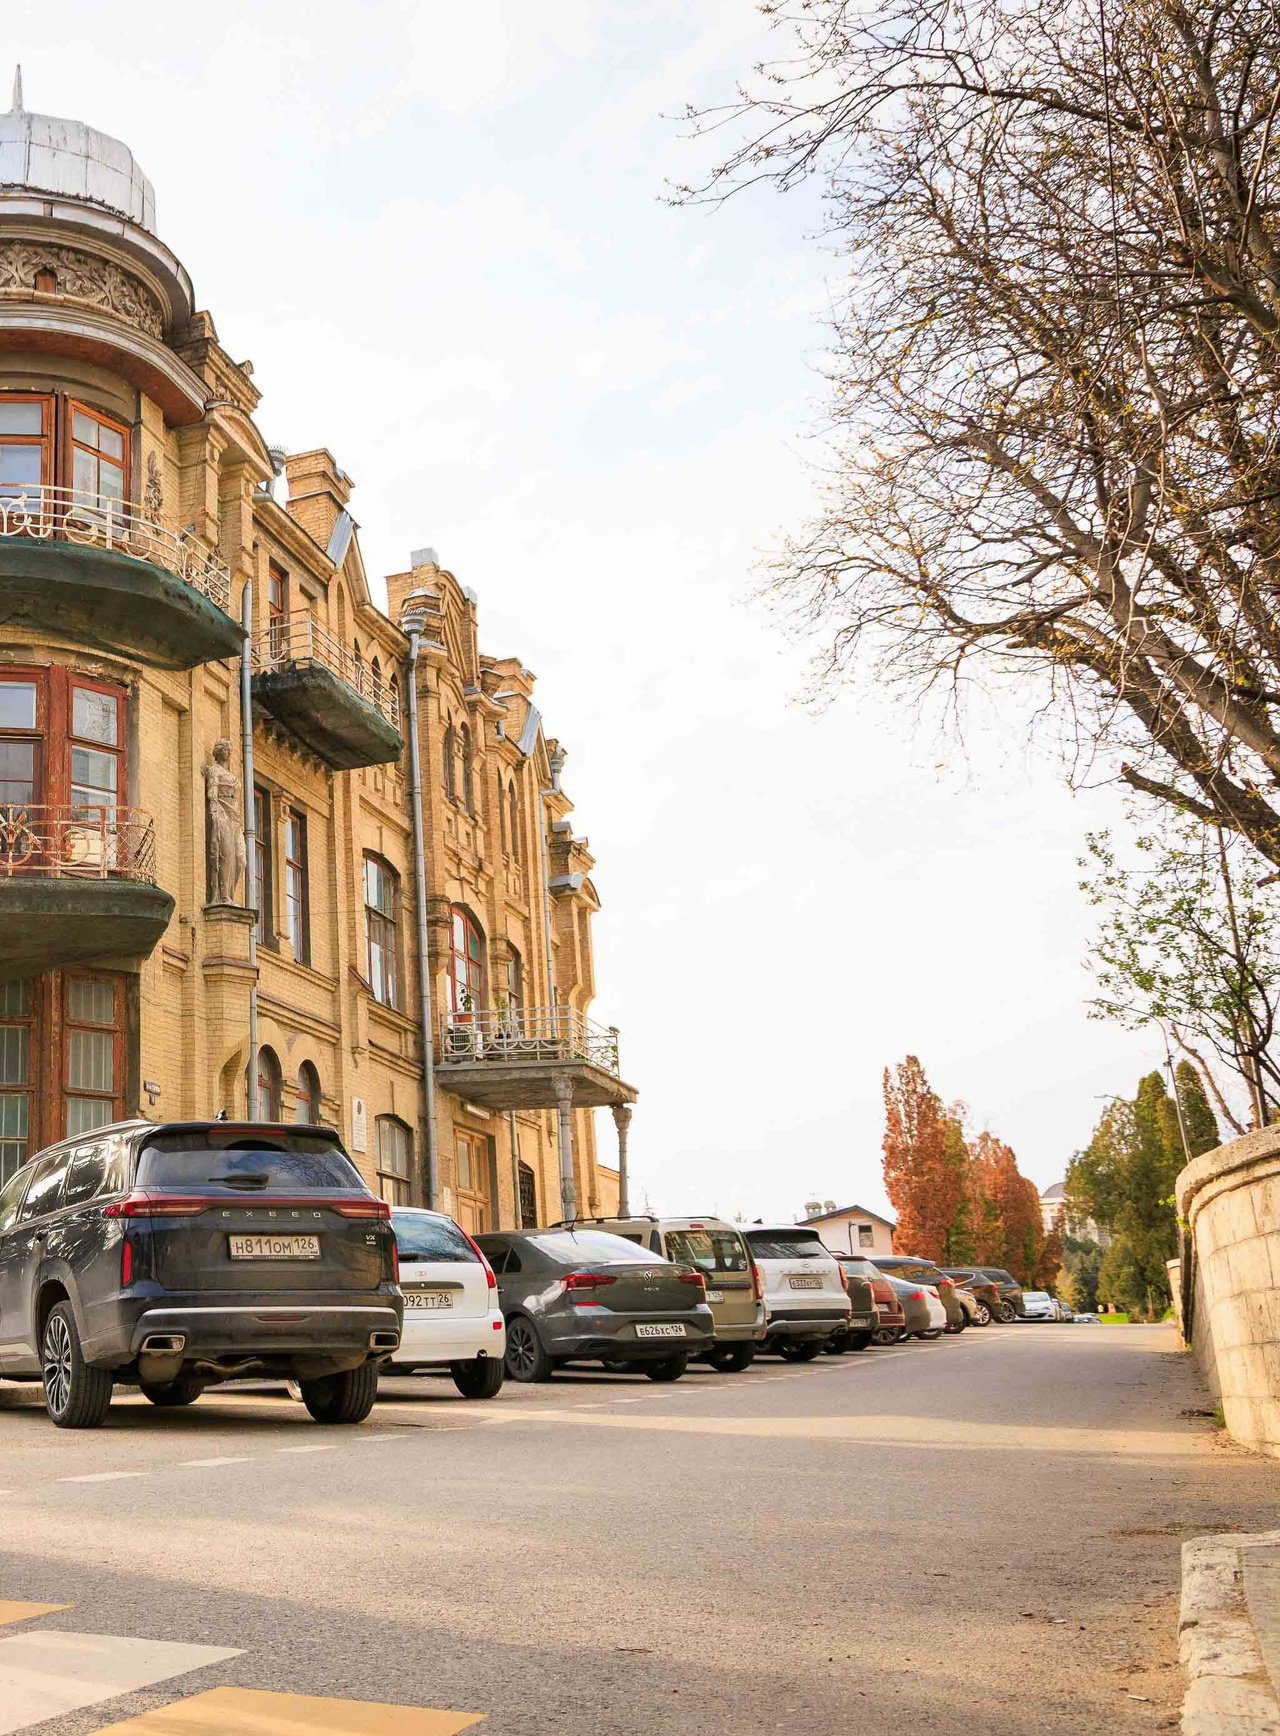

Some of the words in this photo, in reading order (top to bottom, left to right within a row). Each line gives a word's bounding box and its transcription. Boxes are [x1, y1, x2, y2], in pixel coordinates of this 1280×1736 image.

[235, 1238, 292, 1254] Н811ОМ
[294, 1238, 315, 1249] 126
[403, 1295, 436, 1307] 092ТТ
